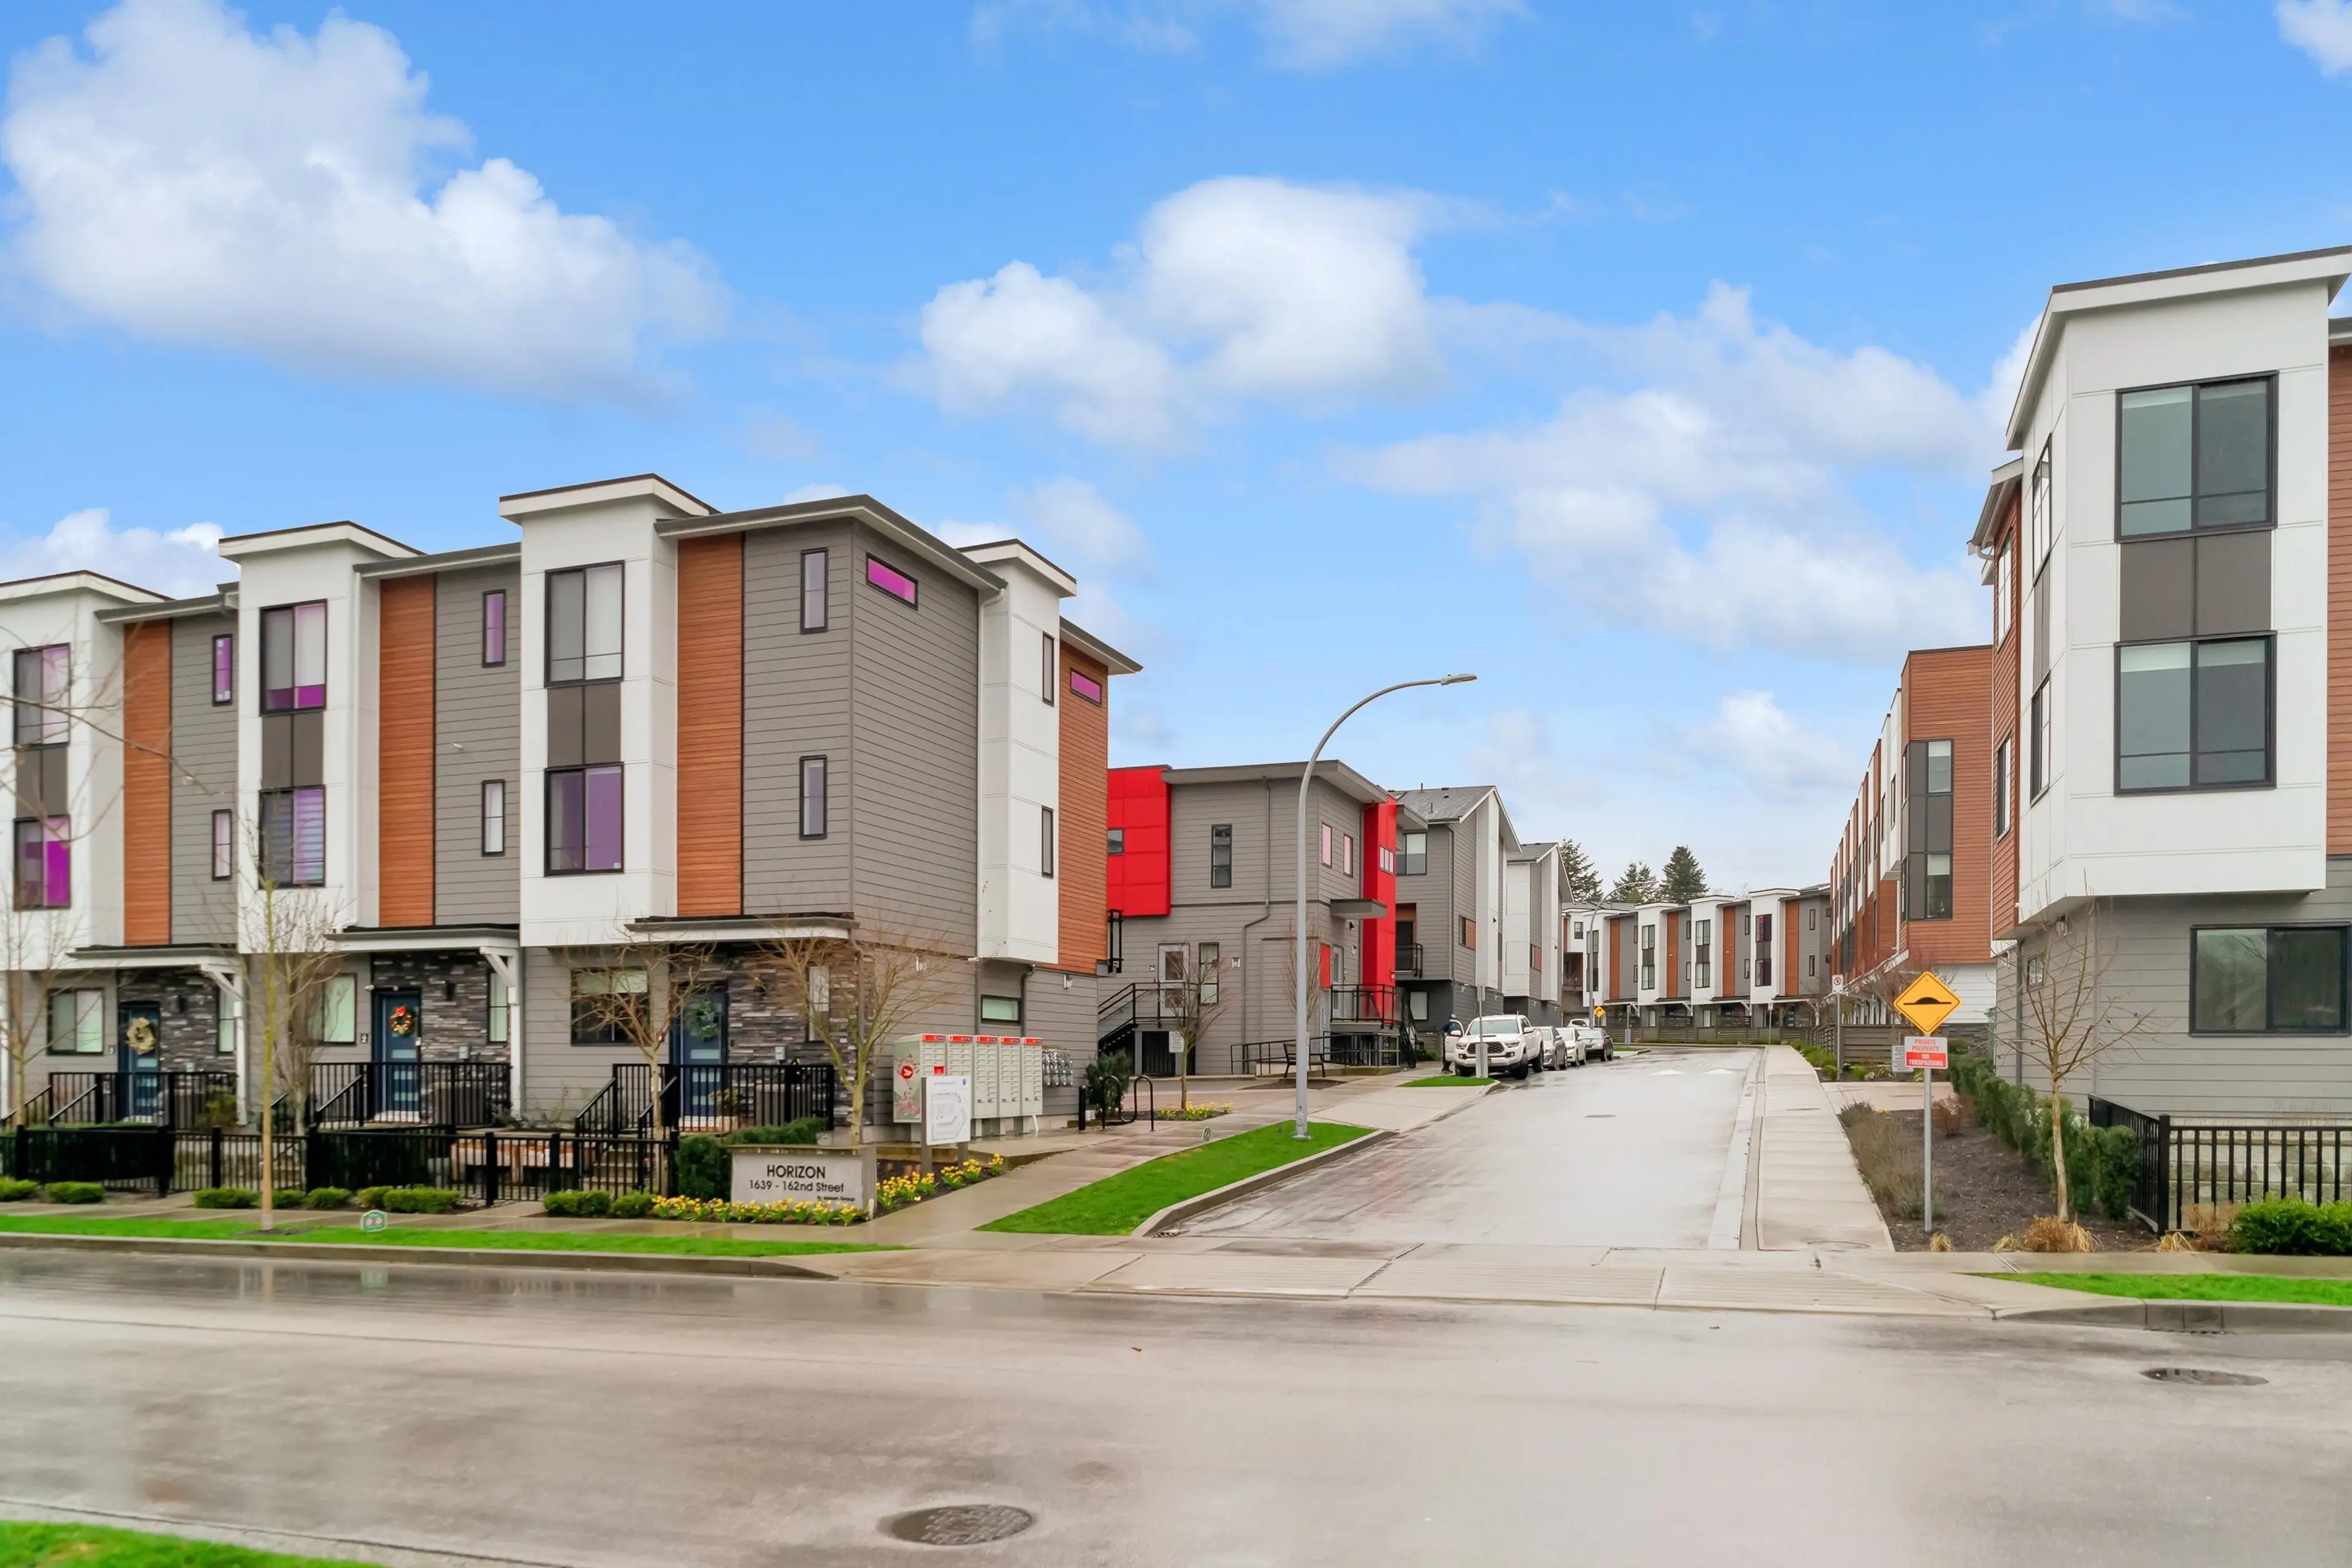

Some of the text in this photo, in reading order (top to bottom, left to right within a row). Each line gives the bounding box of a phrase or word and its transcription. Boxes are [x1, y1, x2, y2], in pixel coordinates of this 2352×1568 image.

[767, 1164, 826, 1178] HORIZON
[749, 1180, 772, 1189] 1639
[783, 1181, 813, 1191] 162nd
[816, 1182, 844, 1193] Street
